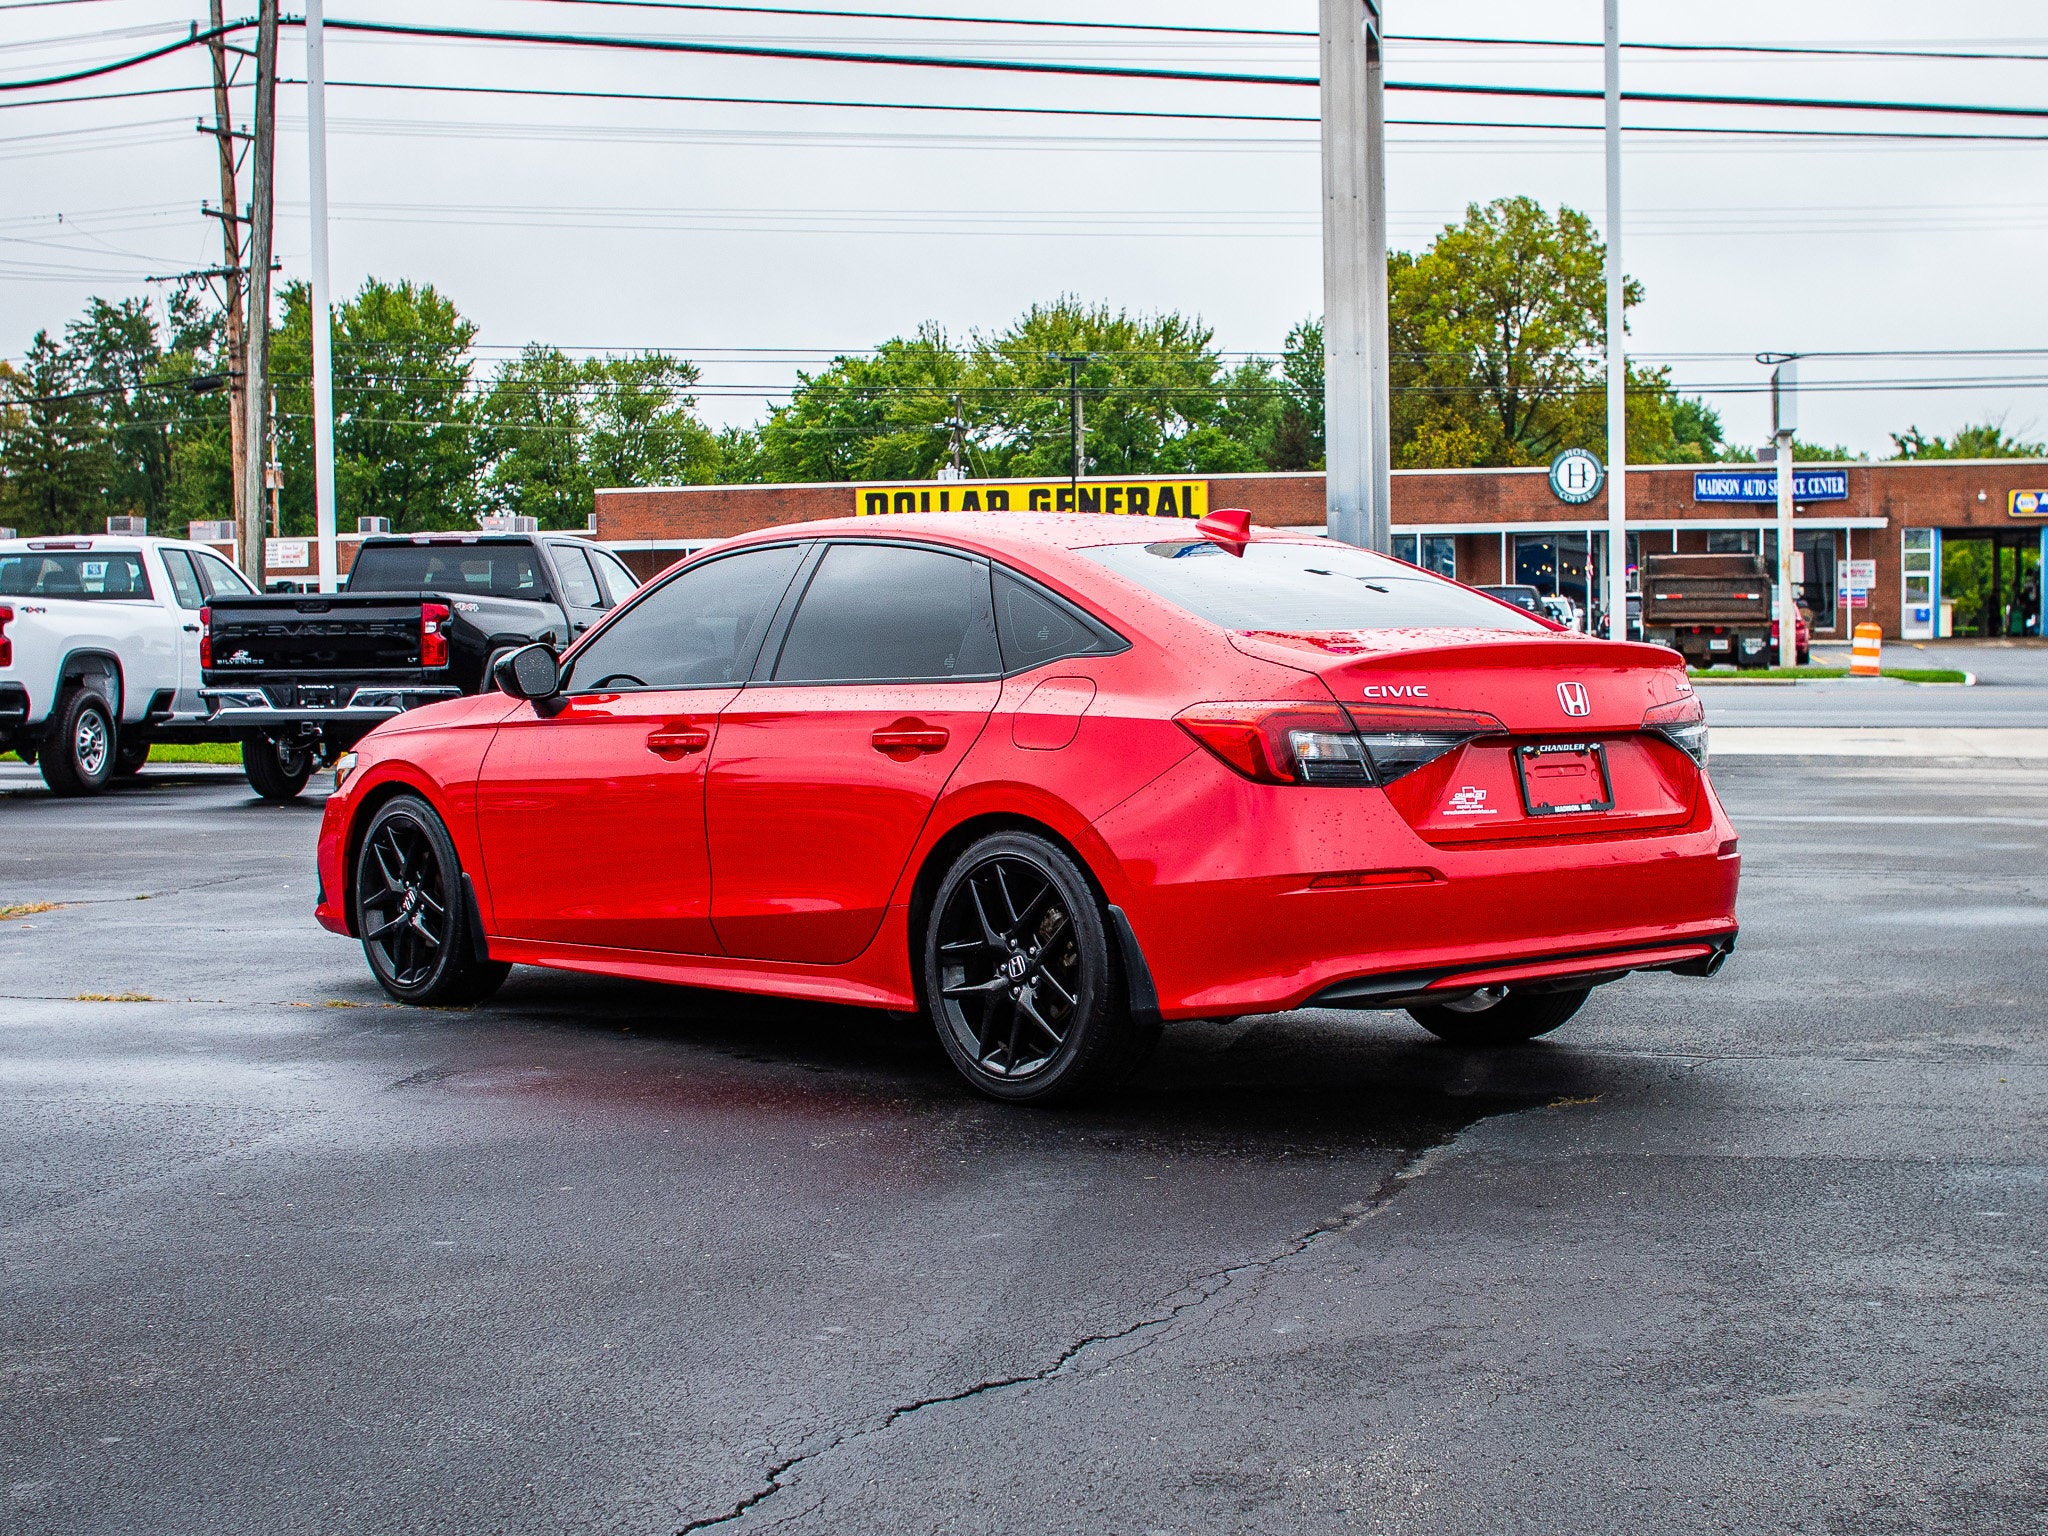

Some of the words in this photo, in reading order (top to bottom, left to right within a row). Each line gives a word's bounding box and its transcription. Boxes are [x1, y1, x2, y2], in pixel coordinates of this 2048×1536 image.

[1697, 478, 1740, 495] MADISON
[1743, 479, 1767, 496] AUTO
[1768, 478, 1806, 496] SECE
[1808, 476, 1844, 494] CENTER
[865, 489, 1010, 515] DOLLAR
[1028, 485, 1200, 519] GENERAL
[1558, 490, 1596, 503] COFFEE
[1363, 685, 1429, 698] CIVIC
[1539, 743, 1585, 752] CHANDLER
